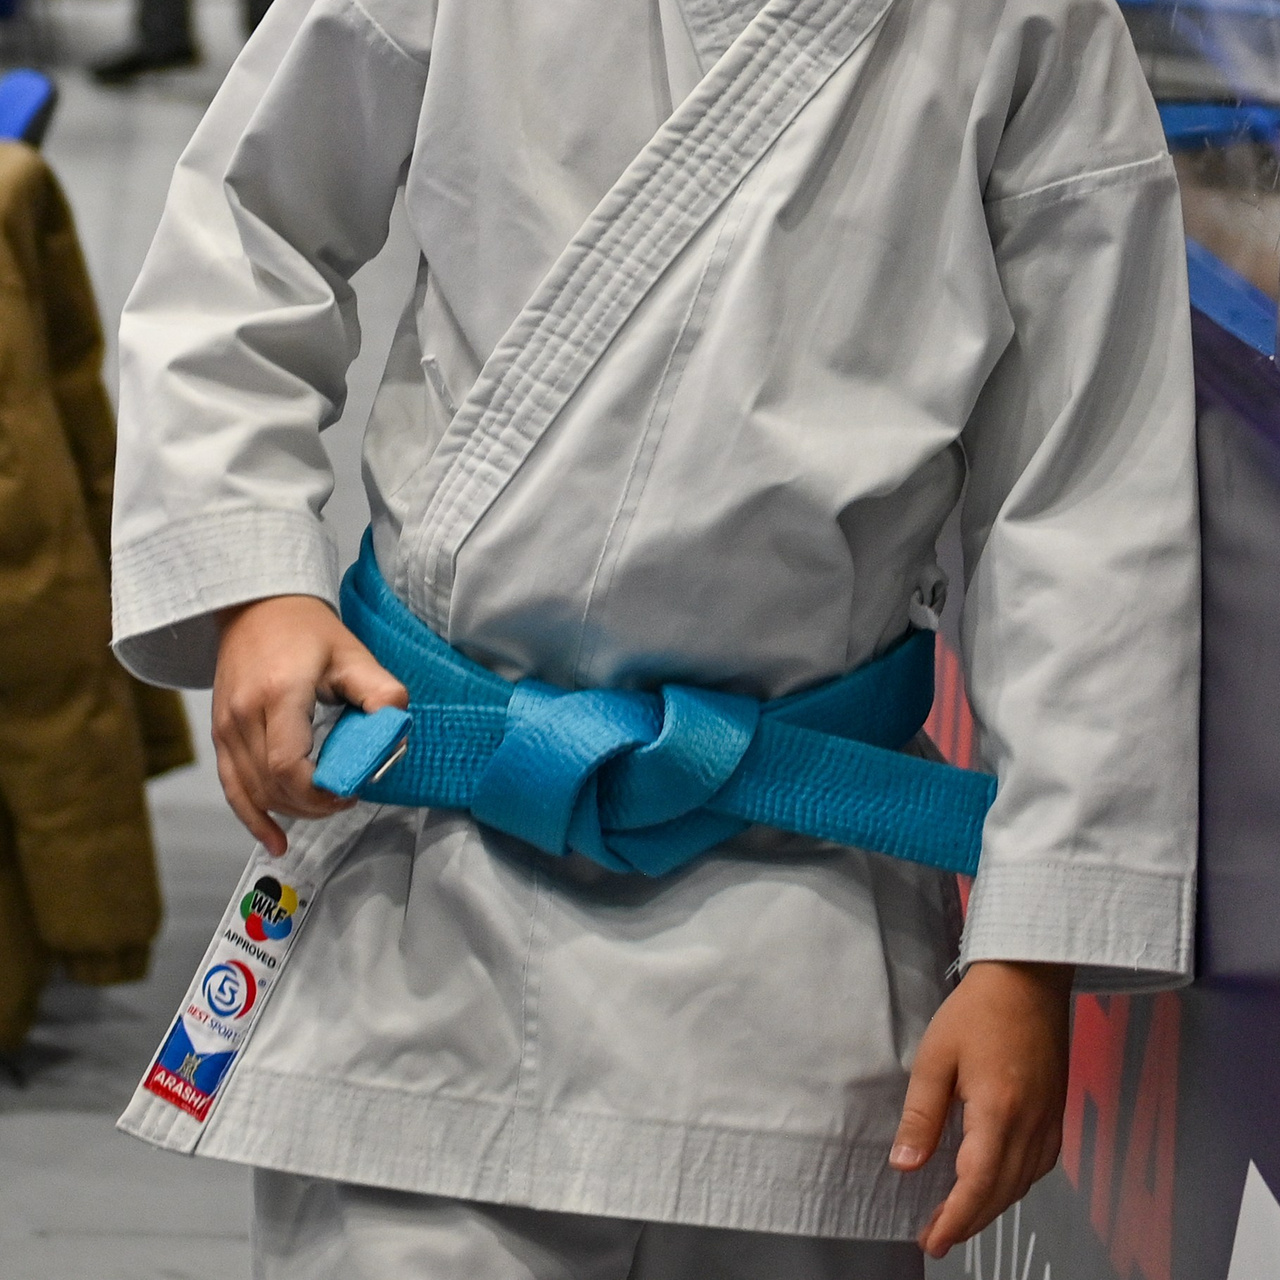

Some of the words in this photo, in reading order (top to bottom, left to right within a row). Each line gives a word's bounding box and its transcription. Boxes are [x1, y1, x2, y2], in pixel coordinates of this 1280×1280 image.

[250, 890, 288, 926] WKF
[224, 929, 277, 969] APPROVED
[187, 1004, 210, 1024] BEST
[154, 1070, 208, 1110] ARASHI
